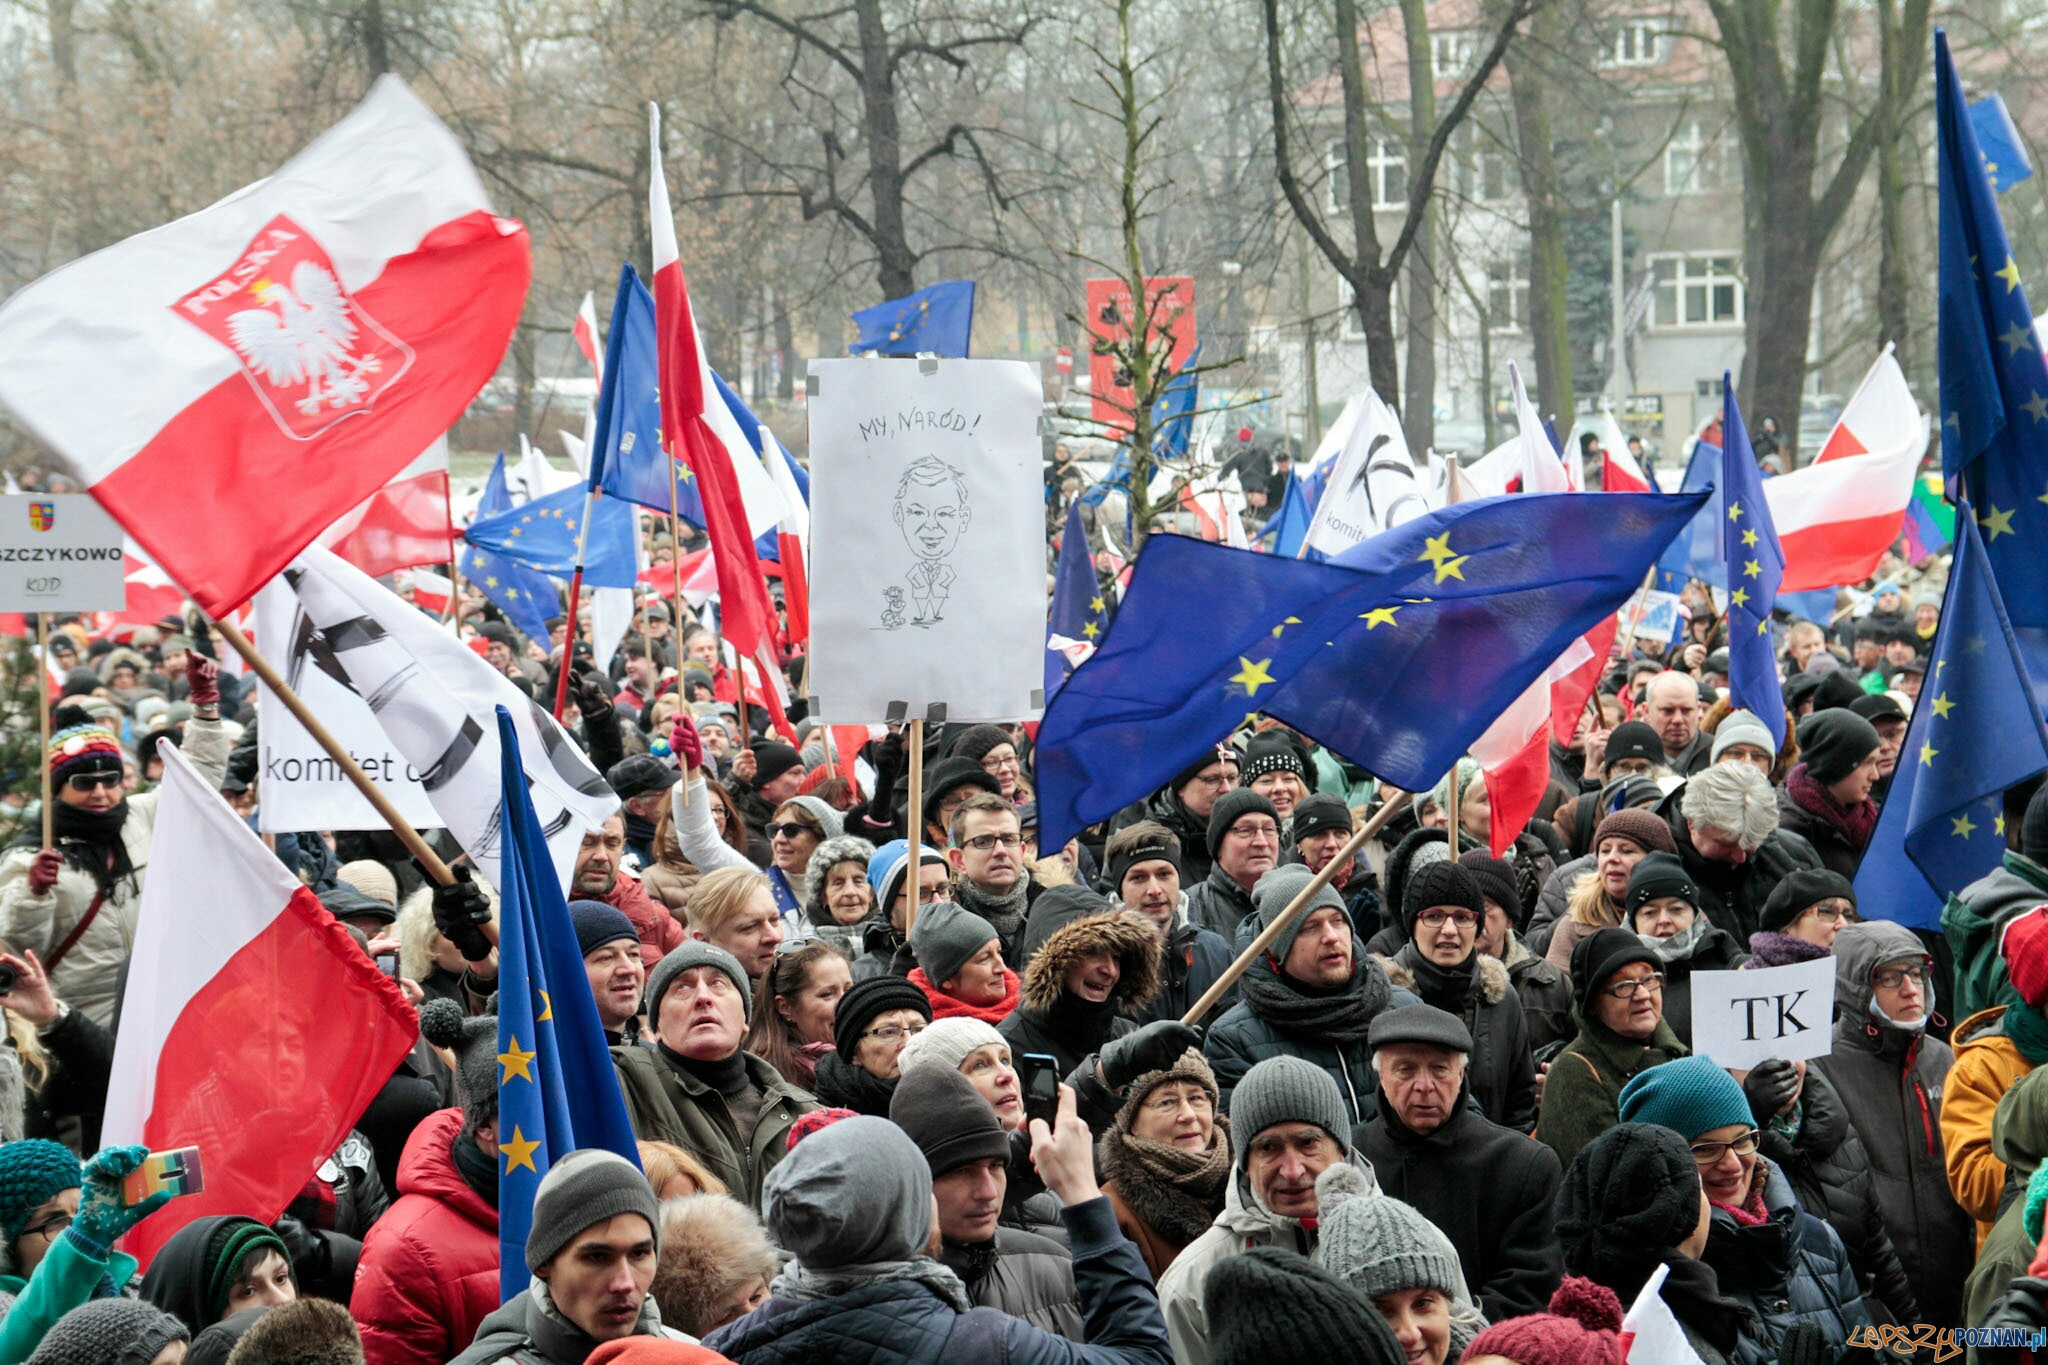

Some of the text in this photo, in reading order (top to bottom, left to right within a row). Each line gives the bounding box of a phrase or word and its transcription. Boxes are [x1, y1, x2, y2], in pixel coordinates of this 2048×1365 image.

[182, 229, 299, 316] POLSKA
[25, 577, 62, 593] KOD
[1731, 989, 1812, 1041] TK
